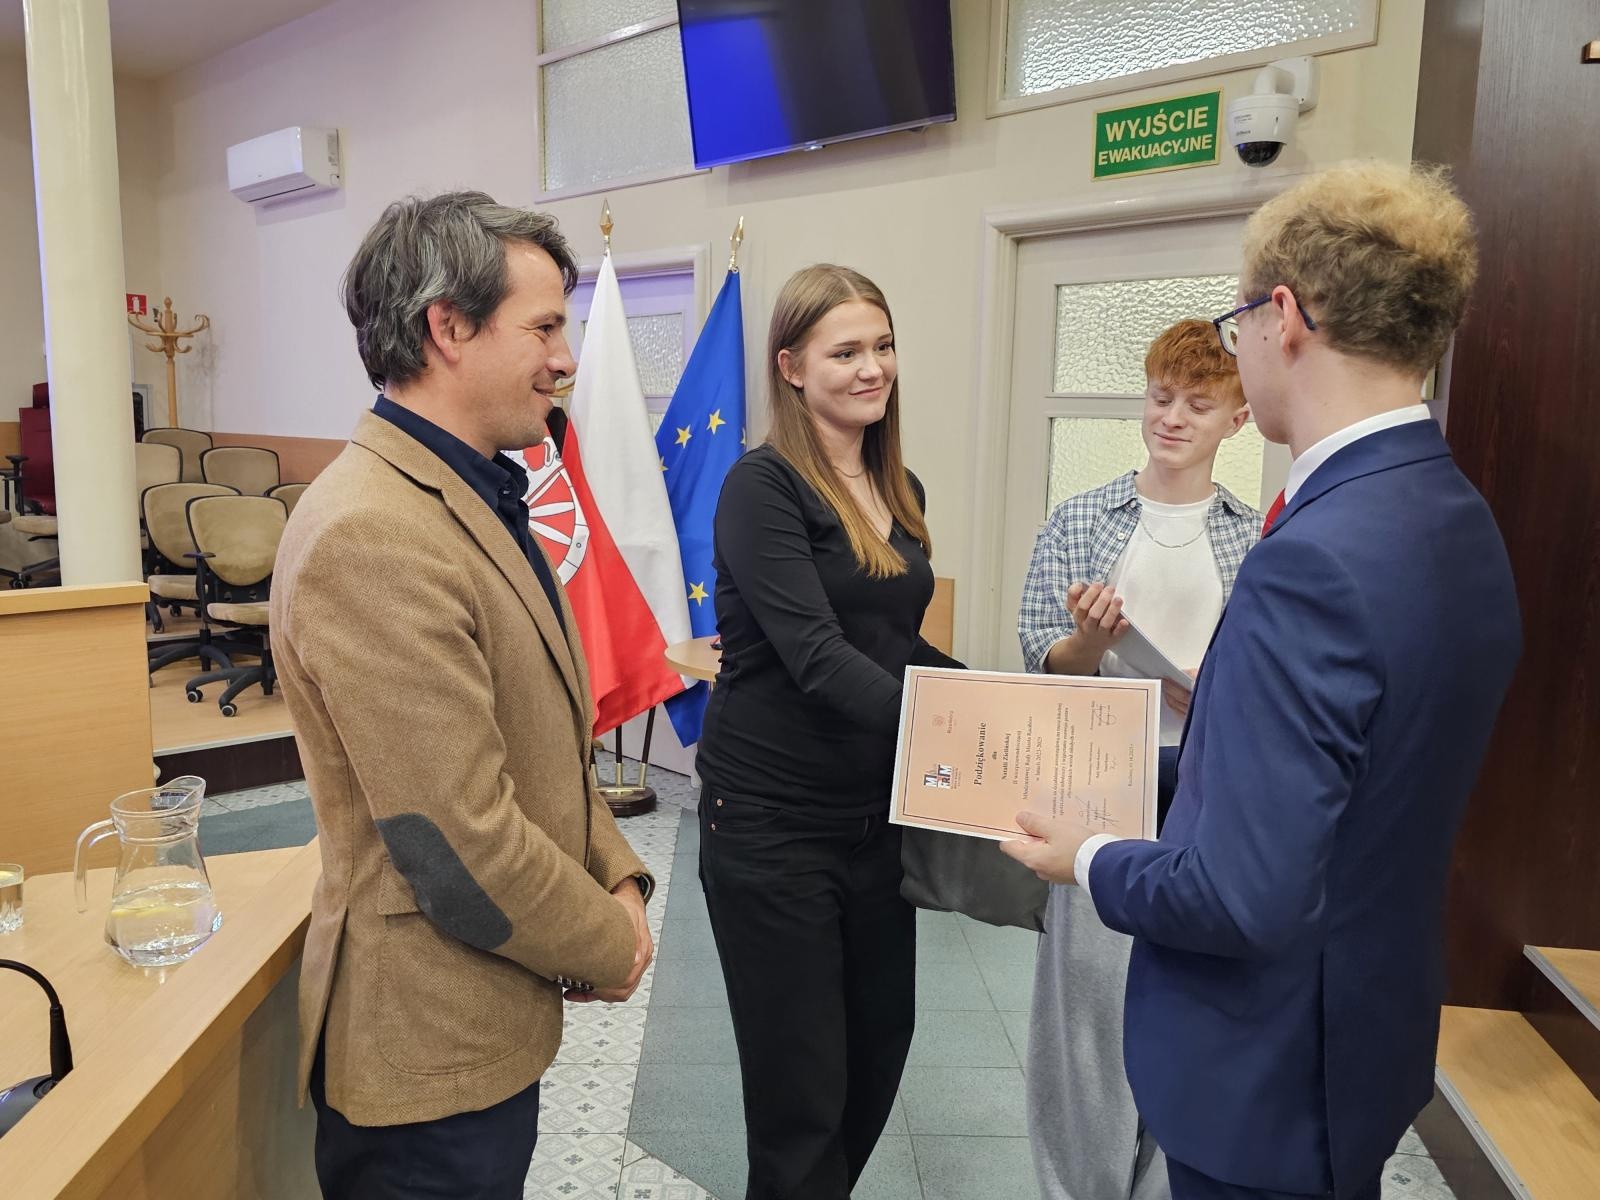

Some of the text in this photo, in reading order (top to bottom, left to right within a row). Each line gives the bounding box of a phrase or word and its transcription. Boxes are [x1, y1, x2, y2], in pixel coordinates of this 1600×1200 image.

[1106, 106, 1209, 143] WYJŚCIE
[1098, 134, 1213, 165] EWAKUACYJNE
[974, 723, 987, 785] Podziękowanie
[1003, 733, 1011, 761] Zielińskiej
